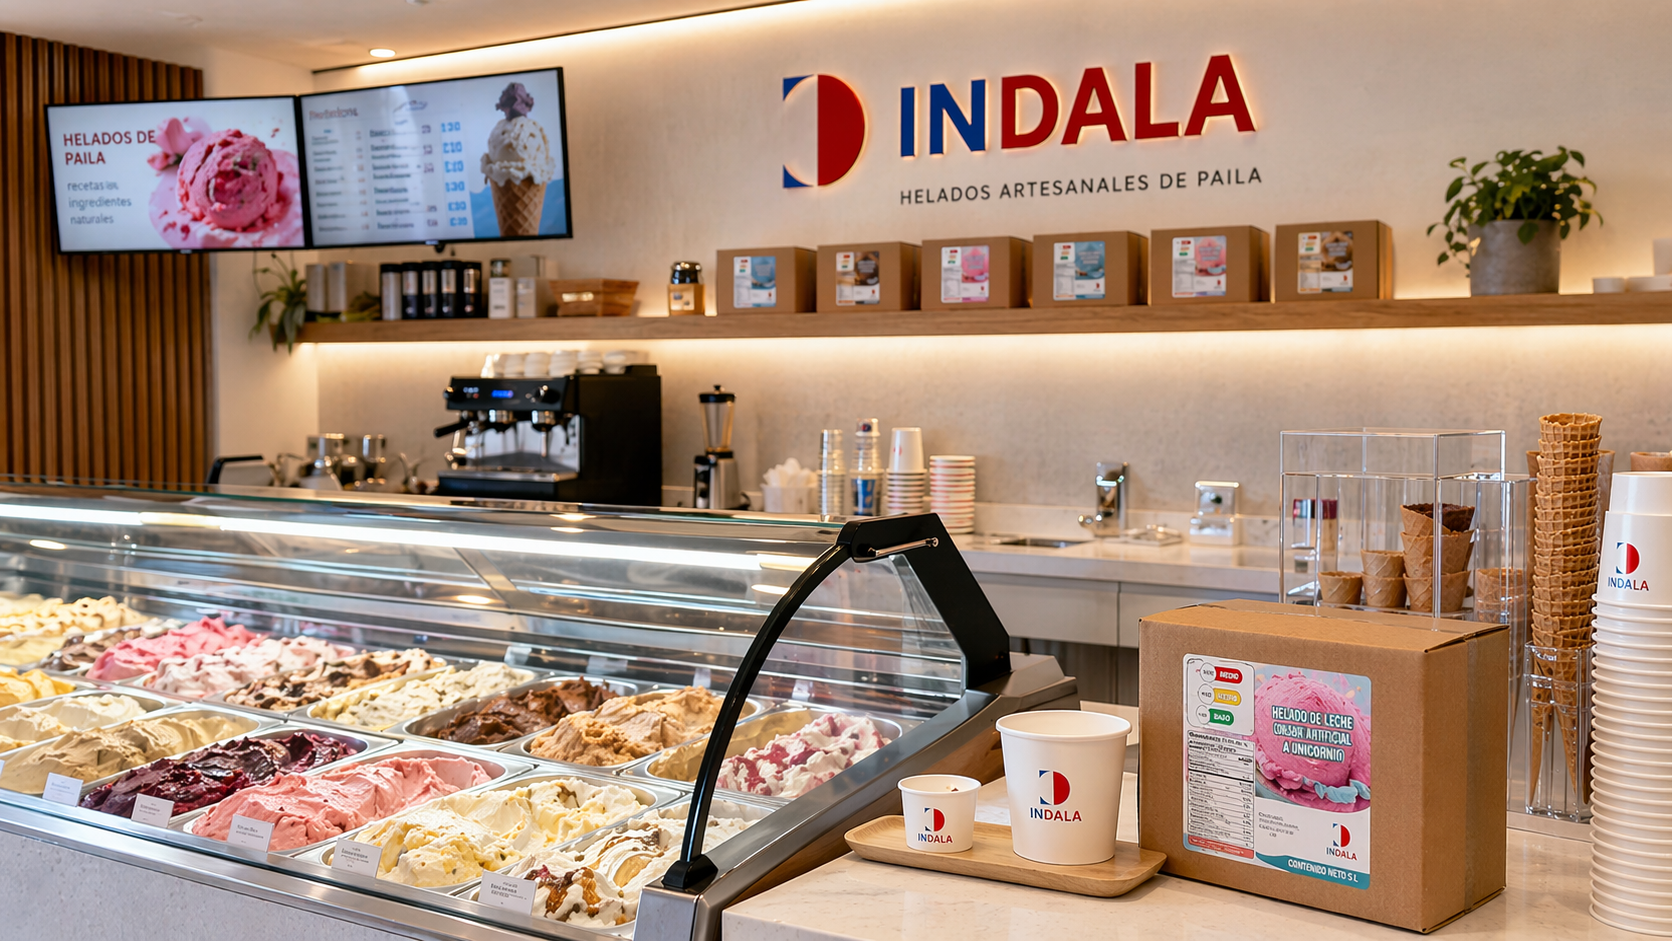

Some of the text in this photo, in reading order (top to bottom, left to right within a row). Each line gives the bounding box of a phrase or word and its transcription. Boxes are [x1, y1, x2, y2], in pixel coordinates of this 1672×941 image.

[899, 54, 1257, 157] INDALA
[63, 129, 156, 147] HELADOS DE
[65, 151, 106, 166] PAILA
[67, 181, 104, 191] recetas
[900, 167, 1263, 205] HELADOS ARTESANALES DE PAILA
[70, 213, 115, 225] naturales
[1607, 576, 1650, 591] INDALA
[1272, 705, 1353, 730] HELADO DE LECHE
[1282, 740, 1344, 762] A UNICORNIO
[1030, 807, 1082, 822] INDALA
[918, 832, 953, 844] INDALA
[1326, 846, 1358, 861] INDALA
